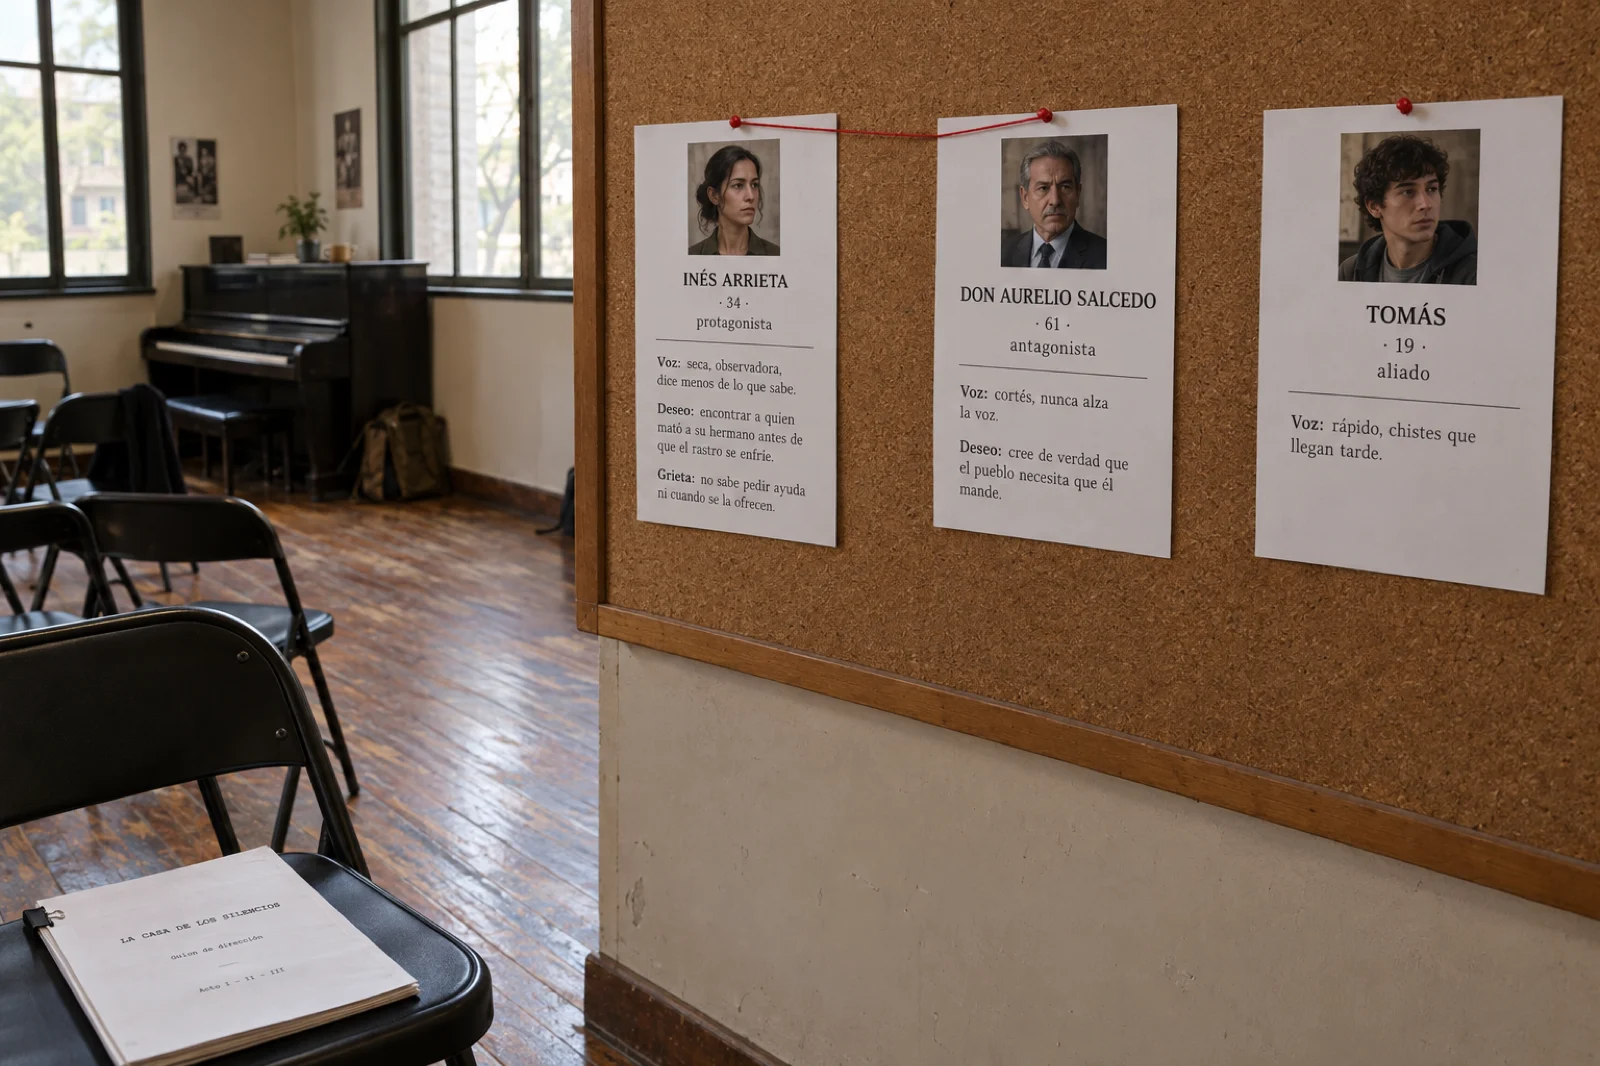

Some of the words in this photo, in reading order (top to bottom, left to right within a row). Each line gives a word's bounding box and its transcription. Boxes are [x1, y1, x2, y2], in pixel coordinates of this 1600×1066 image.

[684, 270, 717, 286] INÉS
[722, 273, 788, 288] ARRIETA
[727, 296, 741, 309] 34
[960, 286, 995, 302] DON
[1000, 288, 1071, 306] AURELIO
[1077, 290, 1156, 309] SALCEDO
[697, 316, 772, 332] protagonista
[1045, 316, 1059, 331] 61
[1366, 302, 1446, 326] TOMÁS
[1010, 340, 1096, 357] antagonista
[1396, 338, 1414, 353] 19
[657, 356, 680, 368] Voz:
[686, 358, 712, 372] seca,
[715, 359, 782, 376] observadora,
[1377, 363, 1430, 381] aliado
[657, 374, 678, 386] dice
[681, 377, 714, 388] menos
[718, 378, 730, 390] de
[734, 378, 745, 391] lo
[747, 383, 766, 395] que
[770, 380, 796, 395] sabe.
[960, 385, 987, 399] Voz:
[995, 389, 1035, 405] cortés,
[1041, 393, 1079, 408] nunca
[1083, 394, 1109, 409] alza
[657, 403, 694, 416] Deseo:
[700, 409, 751, 421] encontrar
[755, 413, 761, 423] a
[765, 412, 795, 427] quien
[960, 405, 971, 419] la
[975, 410, 998, 421] voz.
[658, 423, 682, 434] mató
[685, 427, 691, 435] a
[695, 428, 706, 436] su
[709, 425, 756, 440] hermano
[758, 433, 787, 444] antes
[790, 433, 802, 446] de
[1291, 415, 1323, 431] Voz:
[1332, 418, 1382, 438] rápido,
[1389, 422, 1441, 440] chistes
[1448, 431, 1476, 447] que
[657, 442, 676, 455] que
[679, 441, 688, 453] el
[692, 444, 722, 456] rastro
[726, 449, 736, 458] se
[960, 440, 1001, 456] Deseo:
[1008, 448, 1033, 460] cree
[1038, 448, 1053, 462] de
[1058, 452, 1100, 467] verdad
[1105, 457, 1128, 474] que
[1291, 438, 1333, 458] llegan
[1340, 444, 1382, 460] tarde.
[658, 468, 695, 484] Grieta:
[701, 477, 714, 486] no
[717, 476, 739, 488] sabe
[744, 479, 770, 492] pedir
[774, 484, 805, 497] ayuda
[959, 461, 970, 474] el
[974, 464, 1015, 480] pueblo
[1019, 471, 1069, 486] necesita
[1074, 478, 1097, 492] que
[1102, 477, 1113, 491] él
[658, 488, 667, 499] ni
[671, 491, 705, 503] cuando
[709, 495, 719, 505] se
[723, 493, 730, 506] la
[734, 496, 775, 512] ofrecen.
[960, 485, 1001, 499] mande.
[142, 929, 171, 938] CASA
[175, 923, 191, 931] DE
[196, 917, 217, 926] LOS
